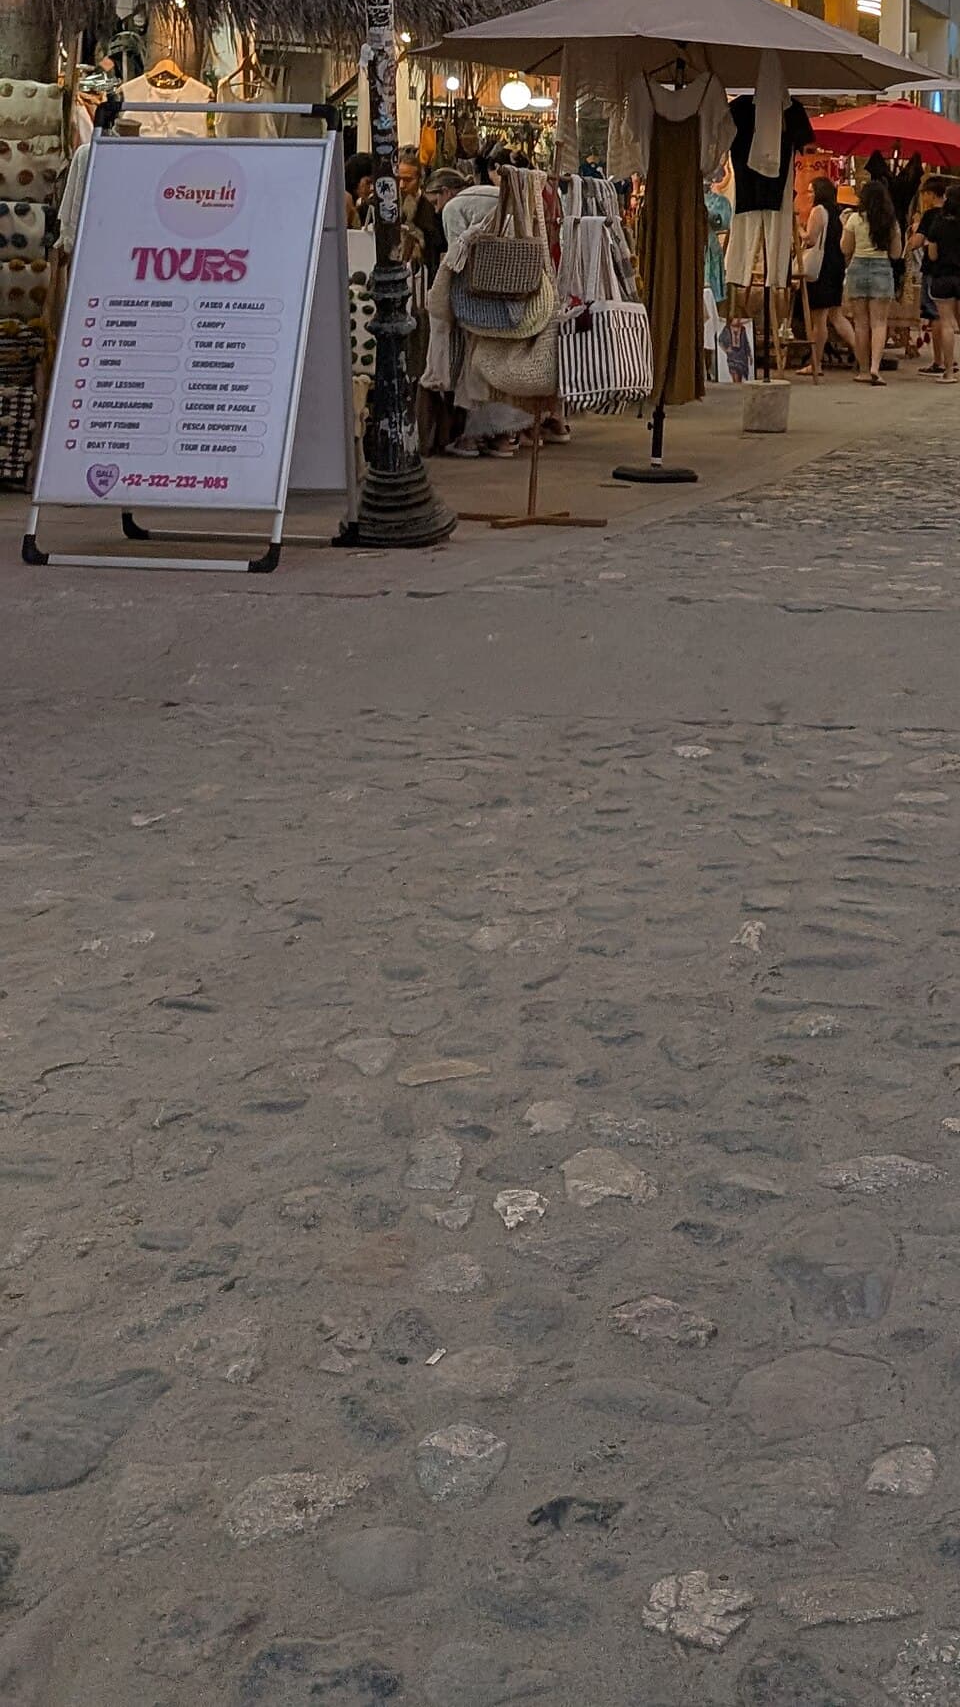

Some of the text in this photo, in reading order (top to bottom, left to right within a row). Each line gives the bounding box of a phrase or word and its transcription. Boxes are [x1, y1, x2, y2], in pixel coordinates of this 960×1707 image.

[131, 247, 249, 282] TOURS
[199, 301, 223, 309] PASEO
[232, 302, 265, 310] CABALLO
[196, 321, 226, 329] CANOPY
[214, 341, 224, 349] DE
[226, 341, 246, 349] MOTO
[115, 381, 145, 389] LESSONS
[230, 384, 249, 392] SURF
[216, 404, 226, 412] DE
[227, 404, 256, 413] PADDLE
[89, 421, 111, 429] SPORT
[182, 423, 248, 432] PESCA DEPORTIVA
[107, 442, 130, 450] TOURS
[200, 444, 210, 452] EN
[211, 444, 237, 453] BARCO
[121, 474, 229, 489] +52-322-232-1083
